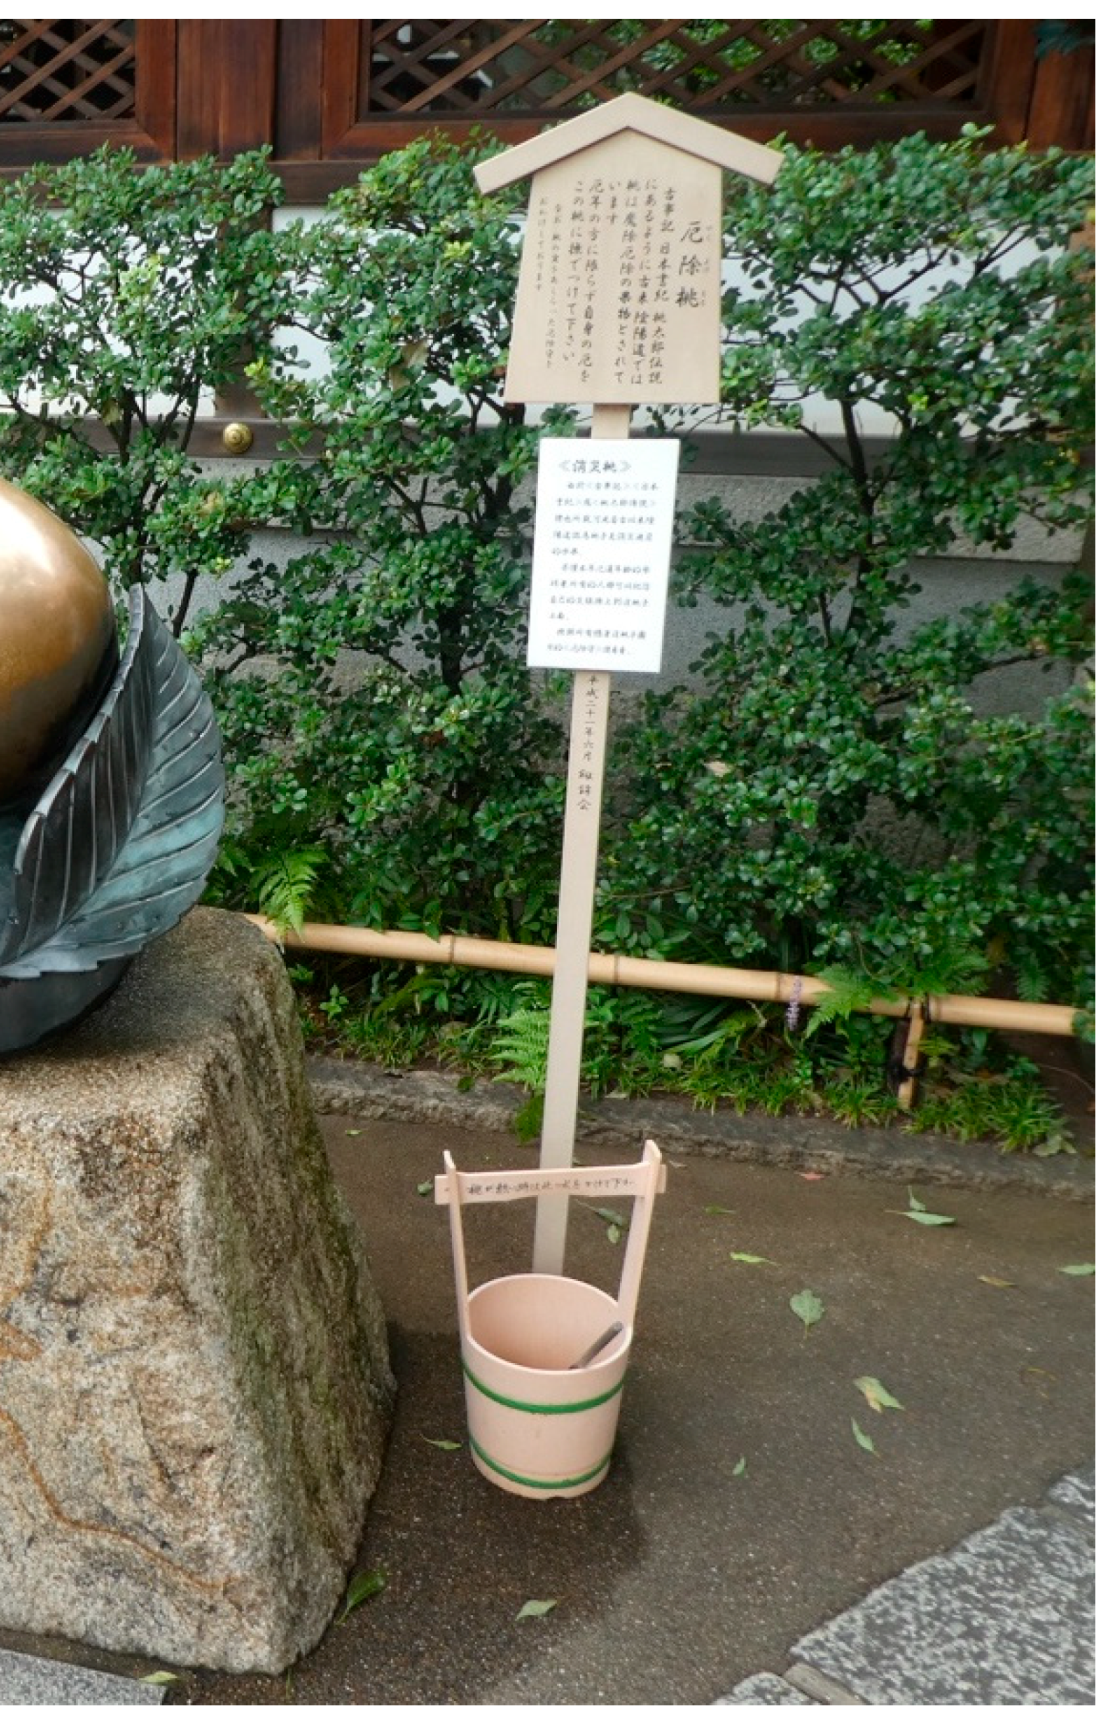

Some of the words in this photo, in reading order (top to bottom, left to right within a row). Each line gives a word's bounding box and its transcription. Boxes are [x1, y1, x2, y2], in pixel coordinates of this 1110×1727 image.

[606, 183, 623, 225] います
[675, 220, 704, 308] 厄除桃
